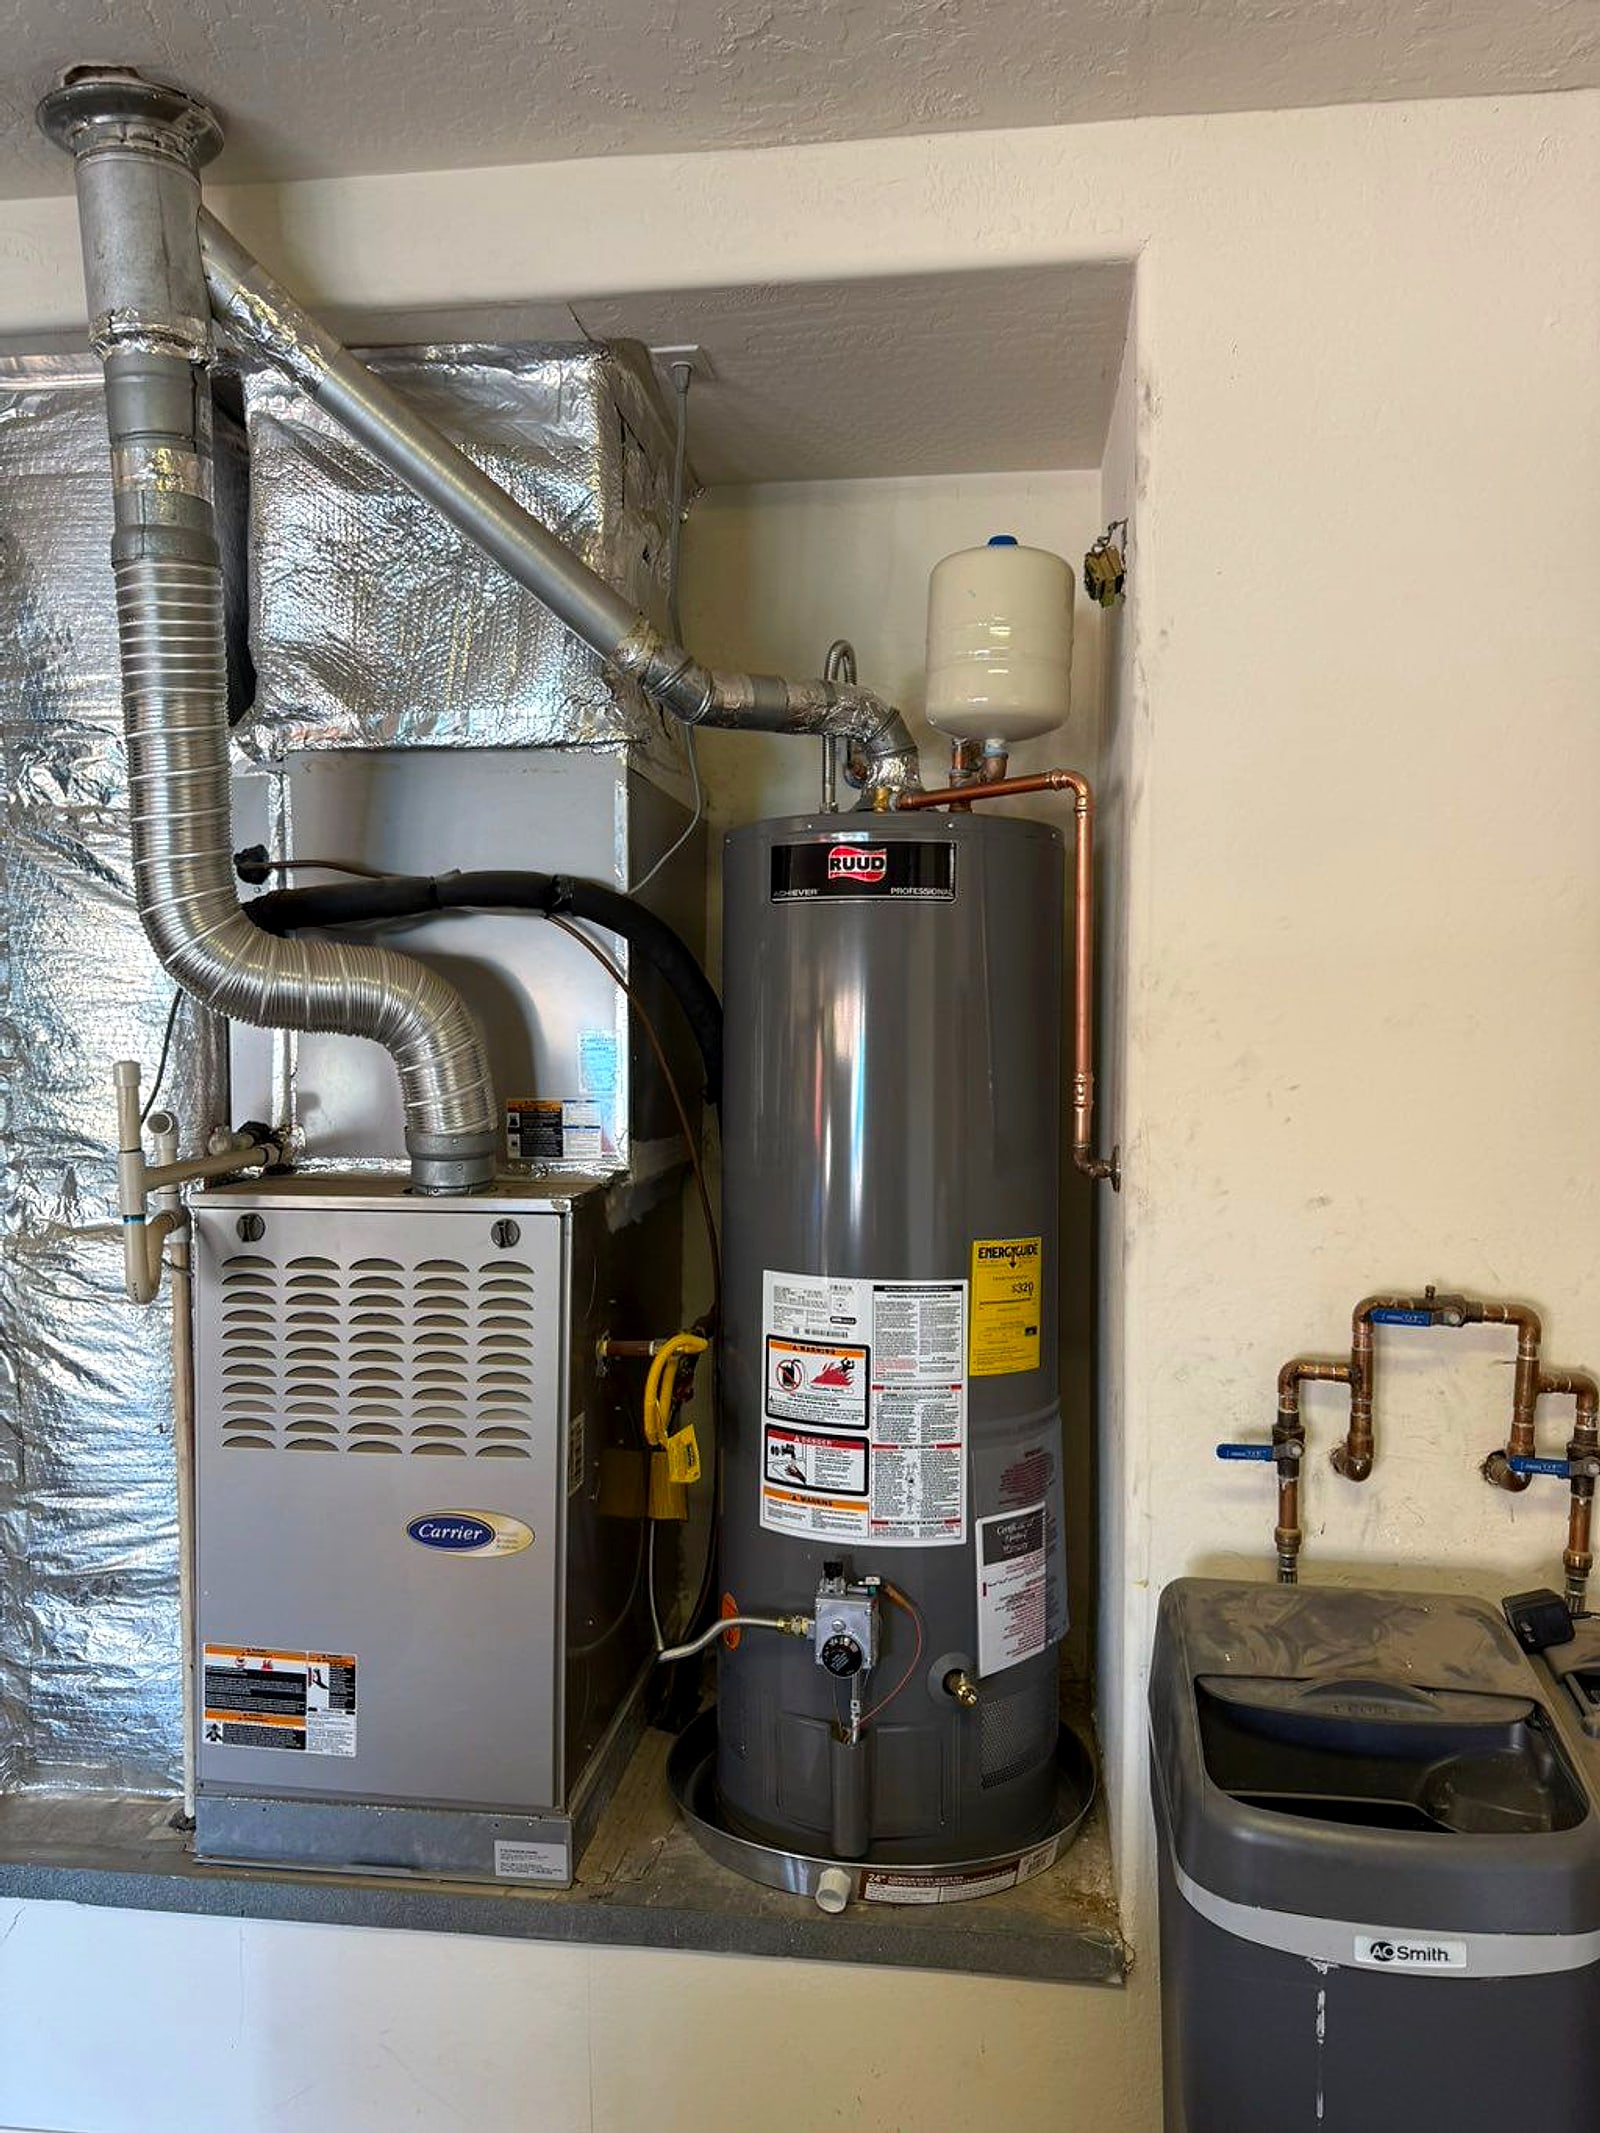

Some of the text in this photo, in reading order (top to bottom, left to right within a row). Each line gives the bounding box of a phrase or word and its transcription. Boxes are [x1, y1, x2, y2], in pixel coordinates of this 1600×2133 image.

[829, 856, 887, 872] RUUD
[773, 887, 953, 898] ACHIEVER PROFESSIONAL
[418, 1523, 484, 1541] Carrier
[1396, 1946, 1449, 1962] Smith
